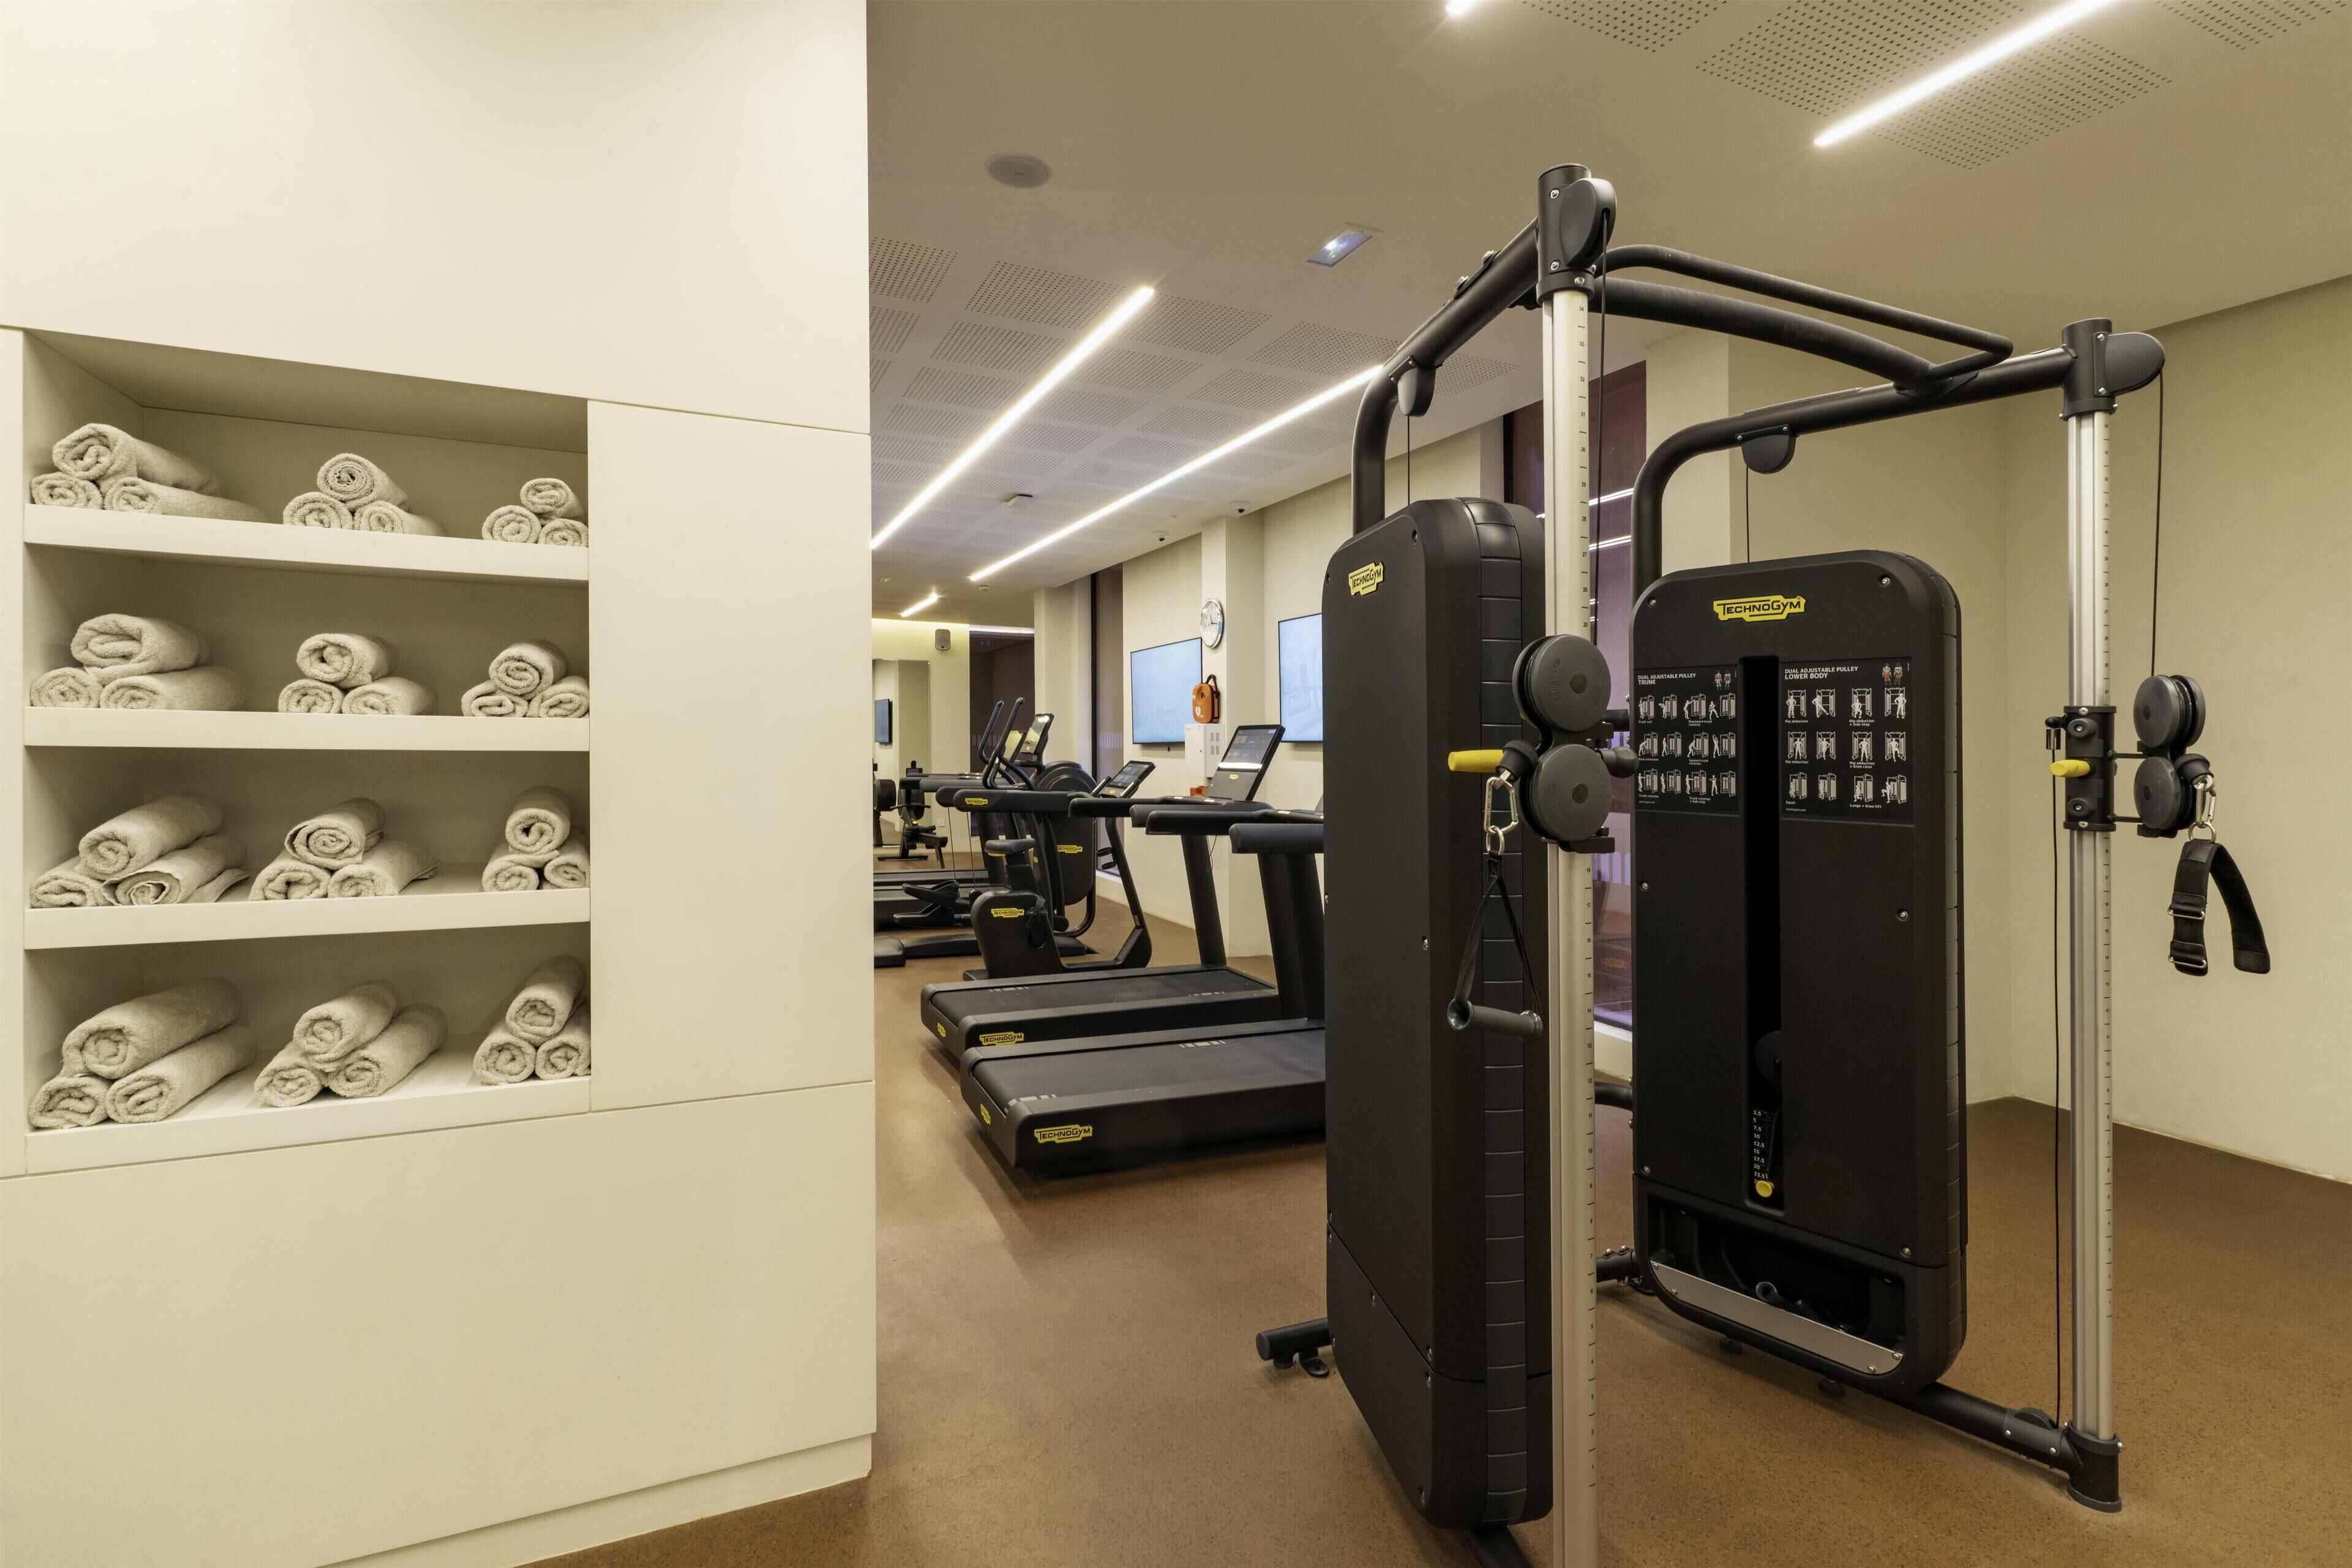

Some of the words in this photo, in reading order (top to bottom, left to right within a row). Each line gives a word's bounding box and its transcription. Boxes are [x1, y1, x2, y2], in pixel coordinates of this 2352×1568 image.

[1717, 599, 1801, 617] TECHNOGYM
[981, 1033, 1022, 1044] TECHNOGYM
[1036, 1128, 1090, 1140] TECHNOGYM
